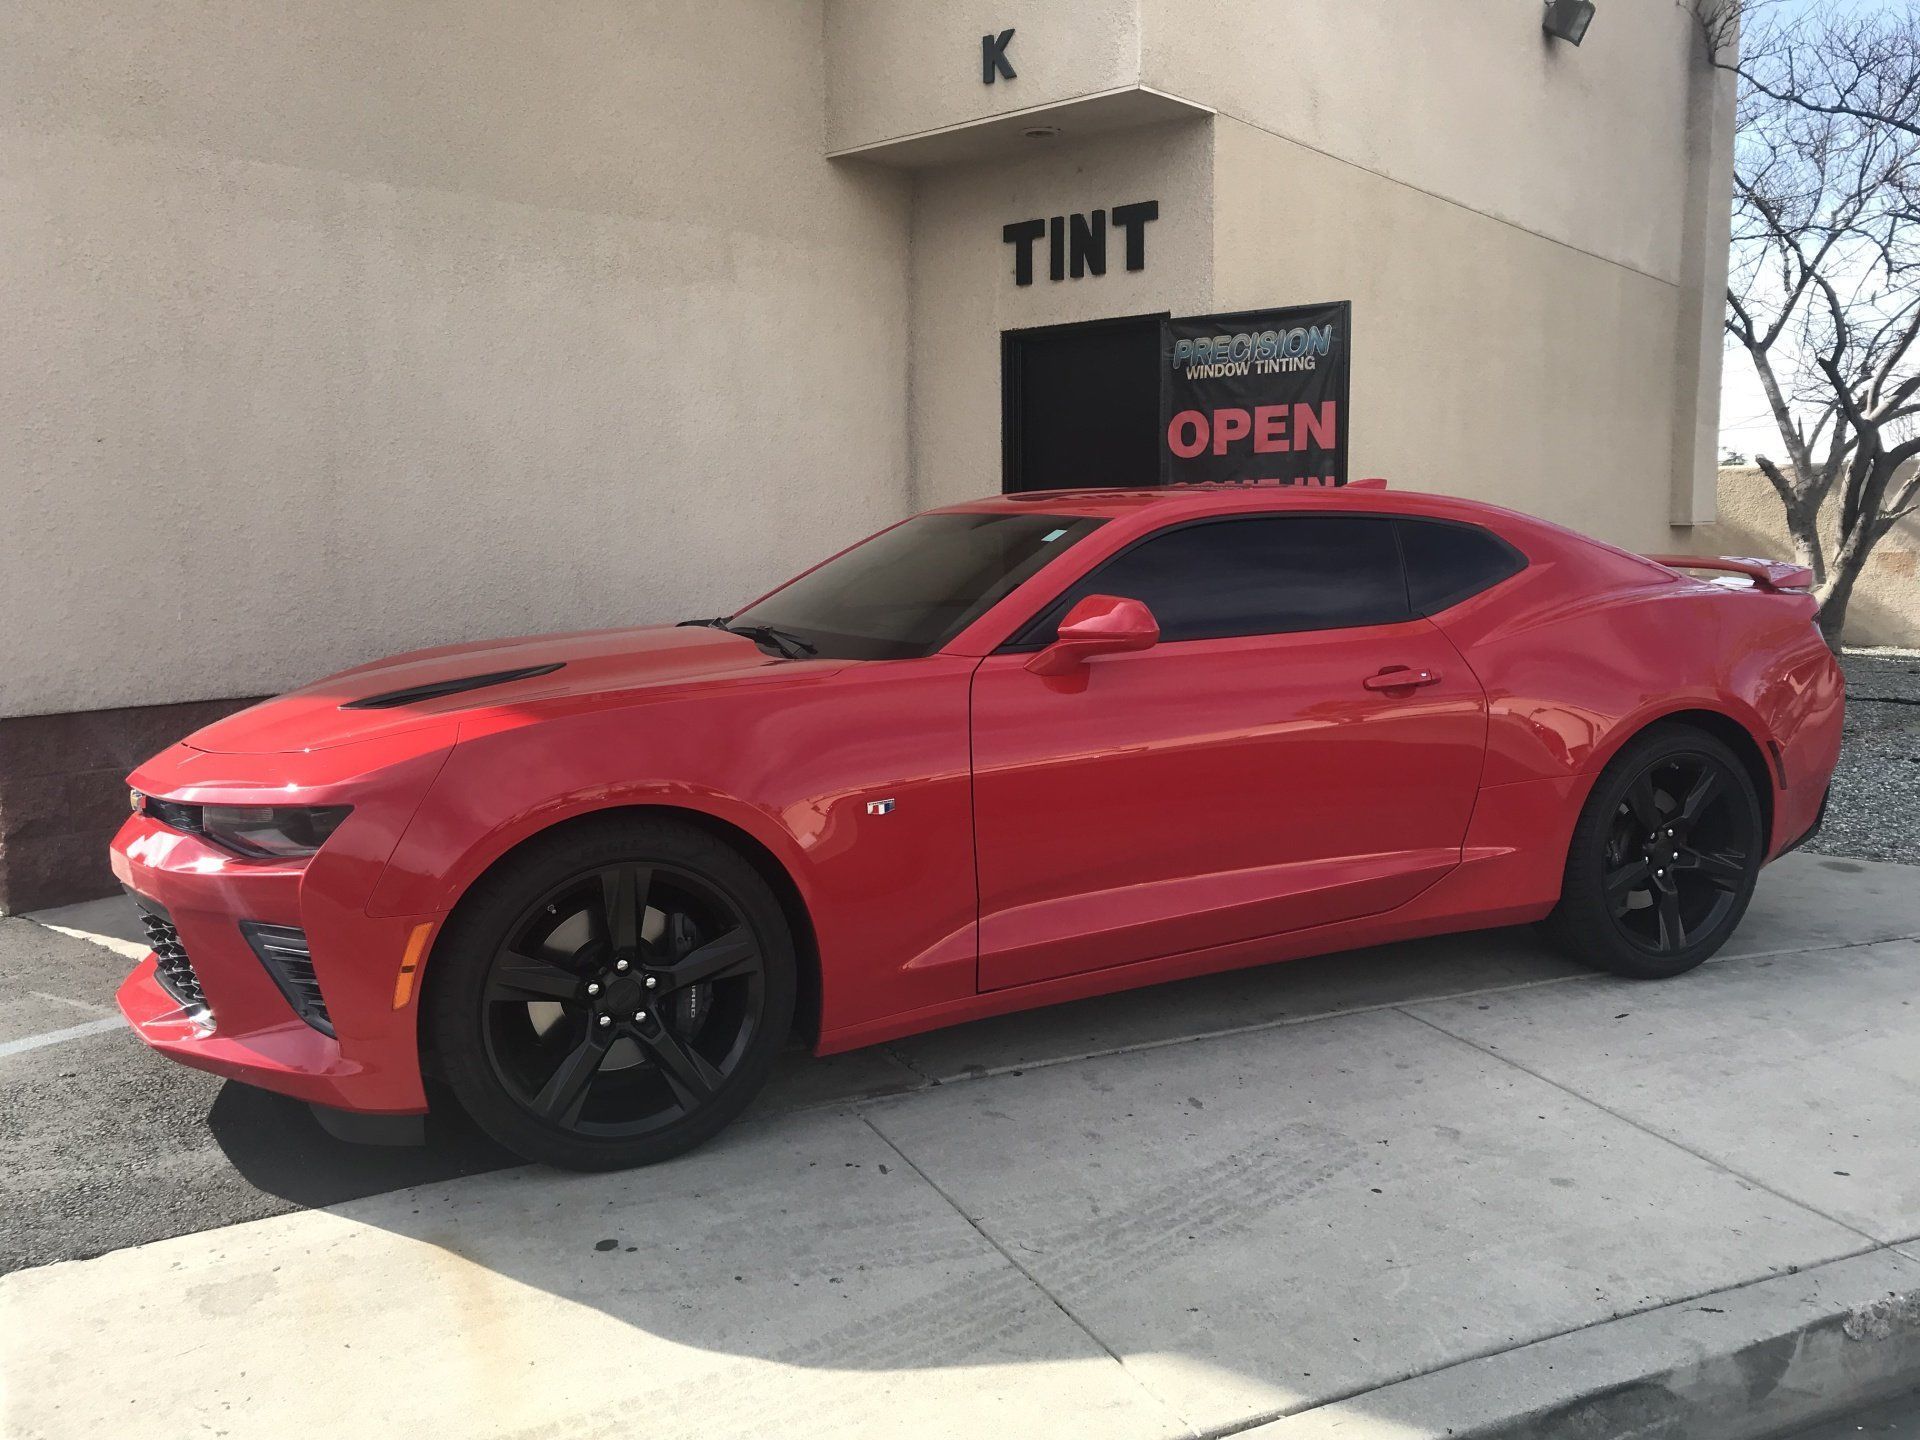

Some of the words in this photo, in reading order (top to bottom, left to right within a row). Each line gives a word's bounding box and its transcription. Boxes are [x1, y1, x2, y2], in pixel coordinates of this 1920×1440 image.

[983, 28, 1017, 84] K
[1003, 200, 1159, 285] TINT
[1173, 324, 1333, 369] PRECISION
[1186, 361, 1250, 380] WINDOW
[1255, 356, 1316, 375] TINTING
[1168, 401, 1336, 459] OPEN
